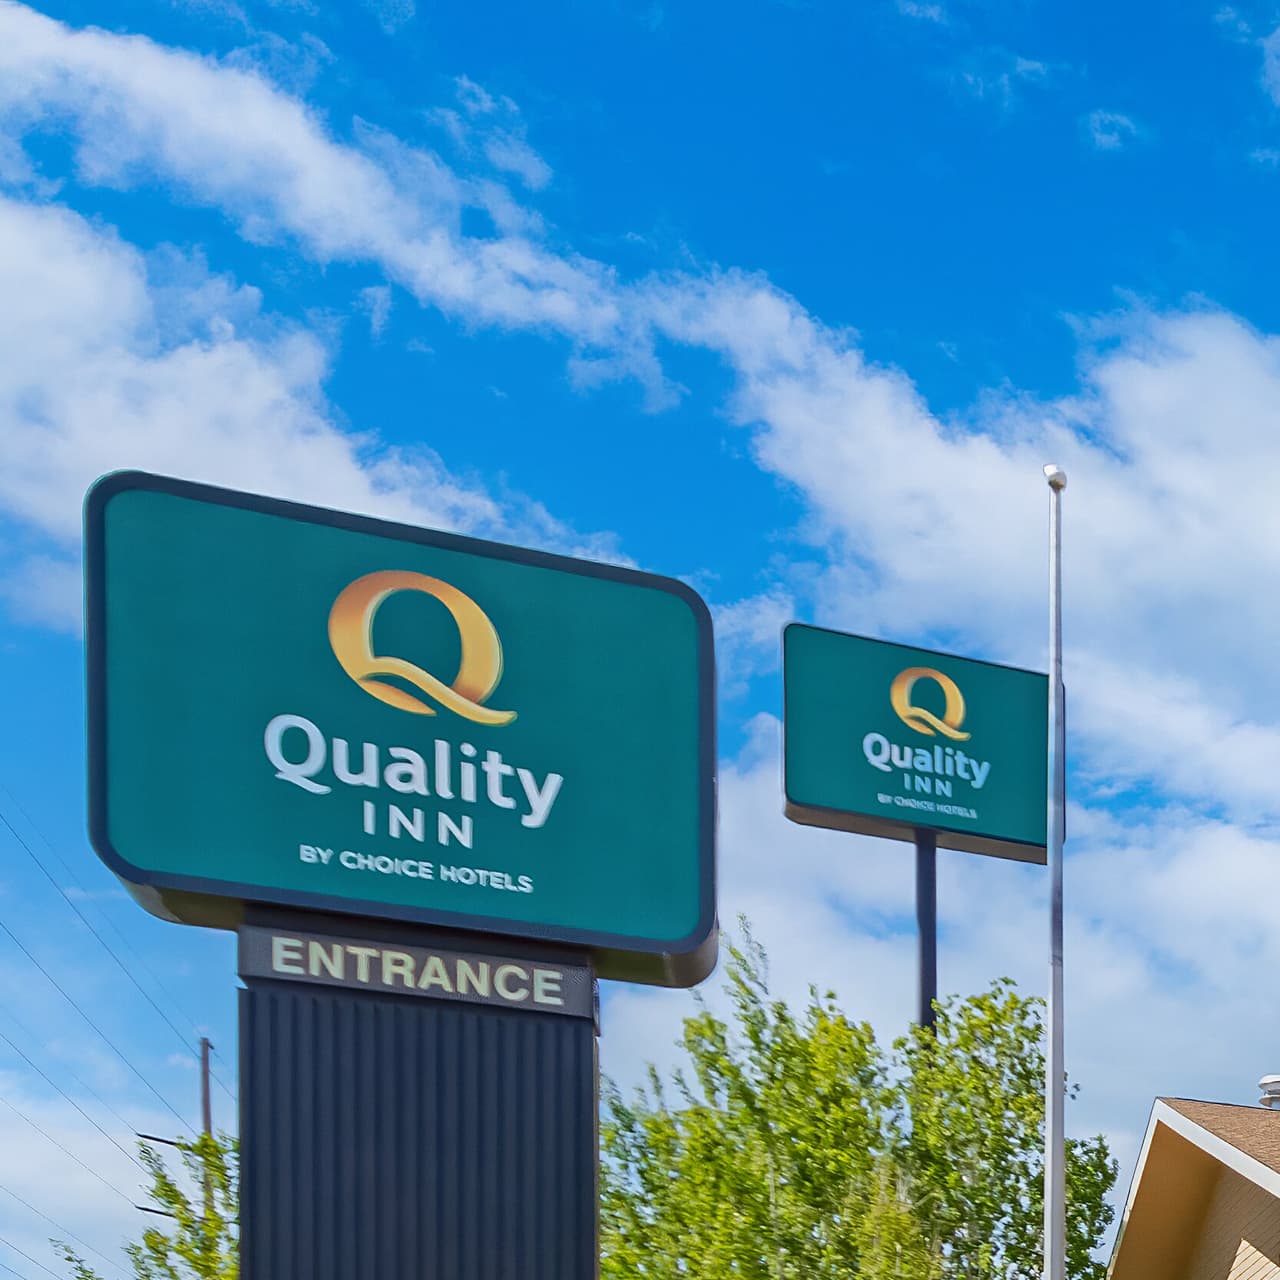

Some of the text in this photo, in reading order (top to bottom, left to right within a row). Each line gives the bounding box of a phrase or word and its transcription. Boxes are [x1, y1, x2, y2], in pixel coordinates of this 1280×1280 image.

[328, 570, 518, 726] Q
[890, 667, 971, 741] Q
[264, 714, 564, 828] Quality
[863, 732, 991, 789] Quality
[904, 773, 952, 797] INN
[363, 800, 473, 849] INN
[299, 844, 534, 893] BY CHOICE HOTELS
[271, 935, 564, 1005] ENTRANCE
